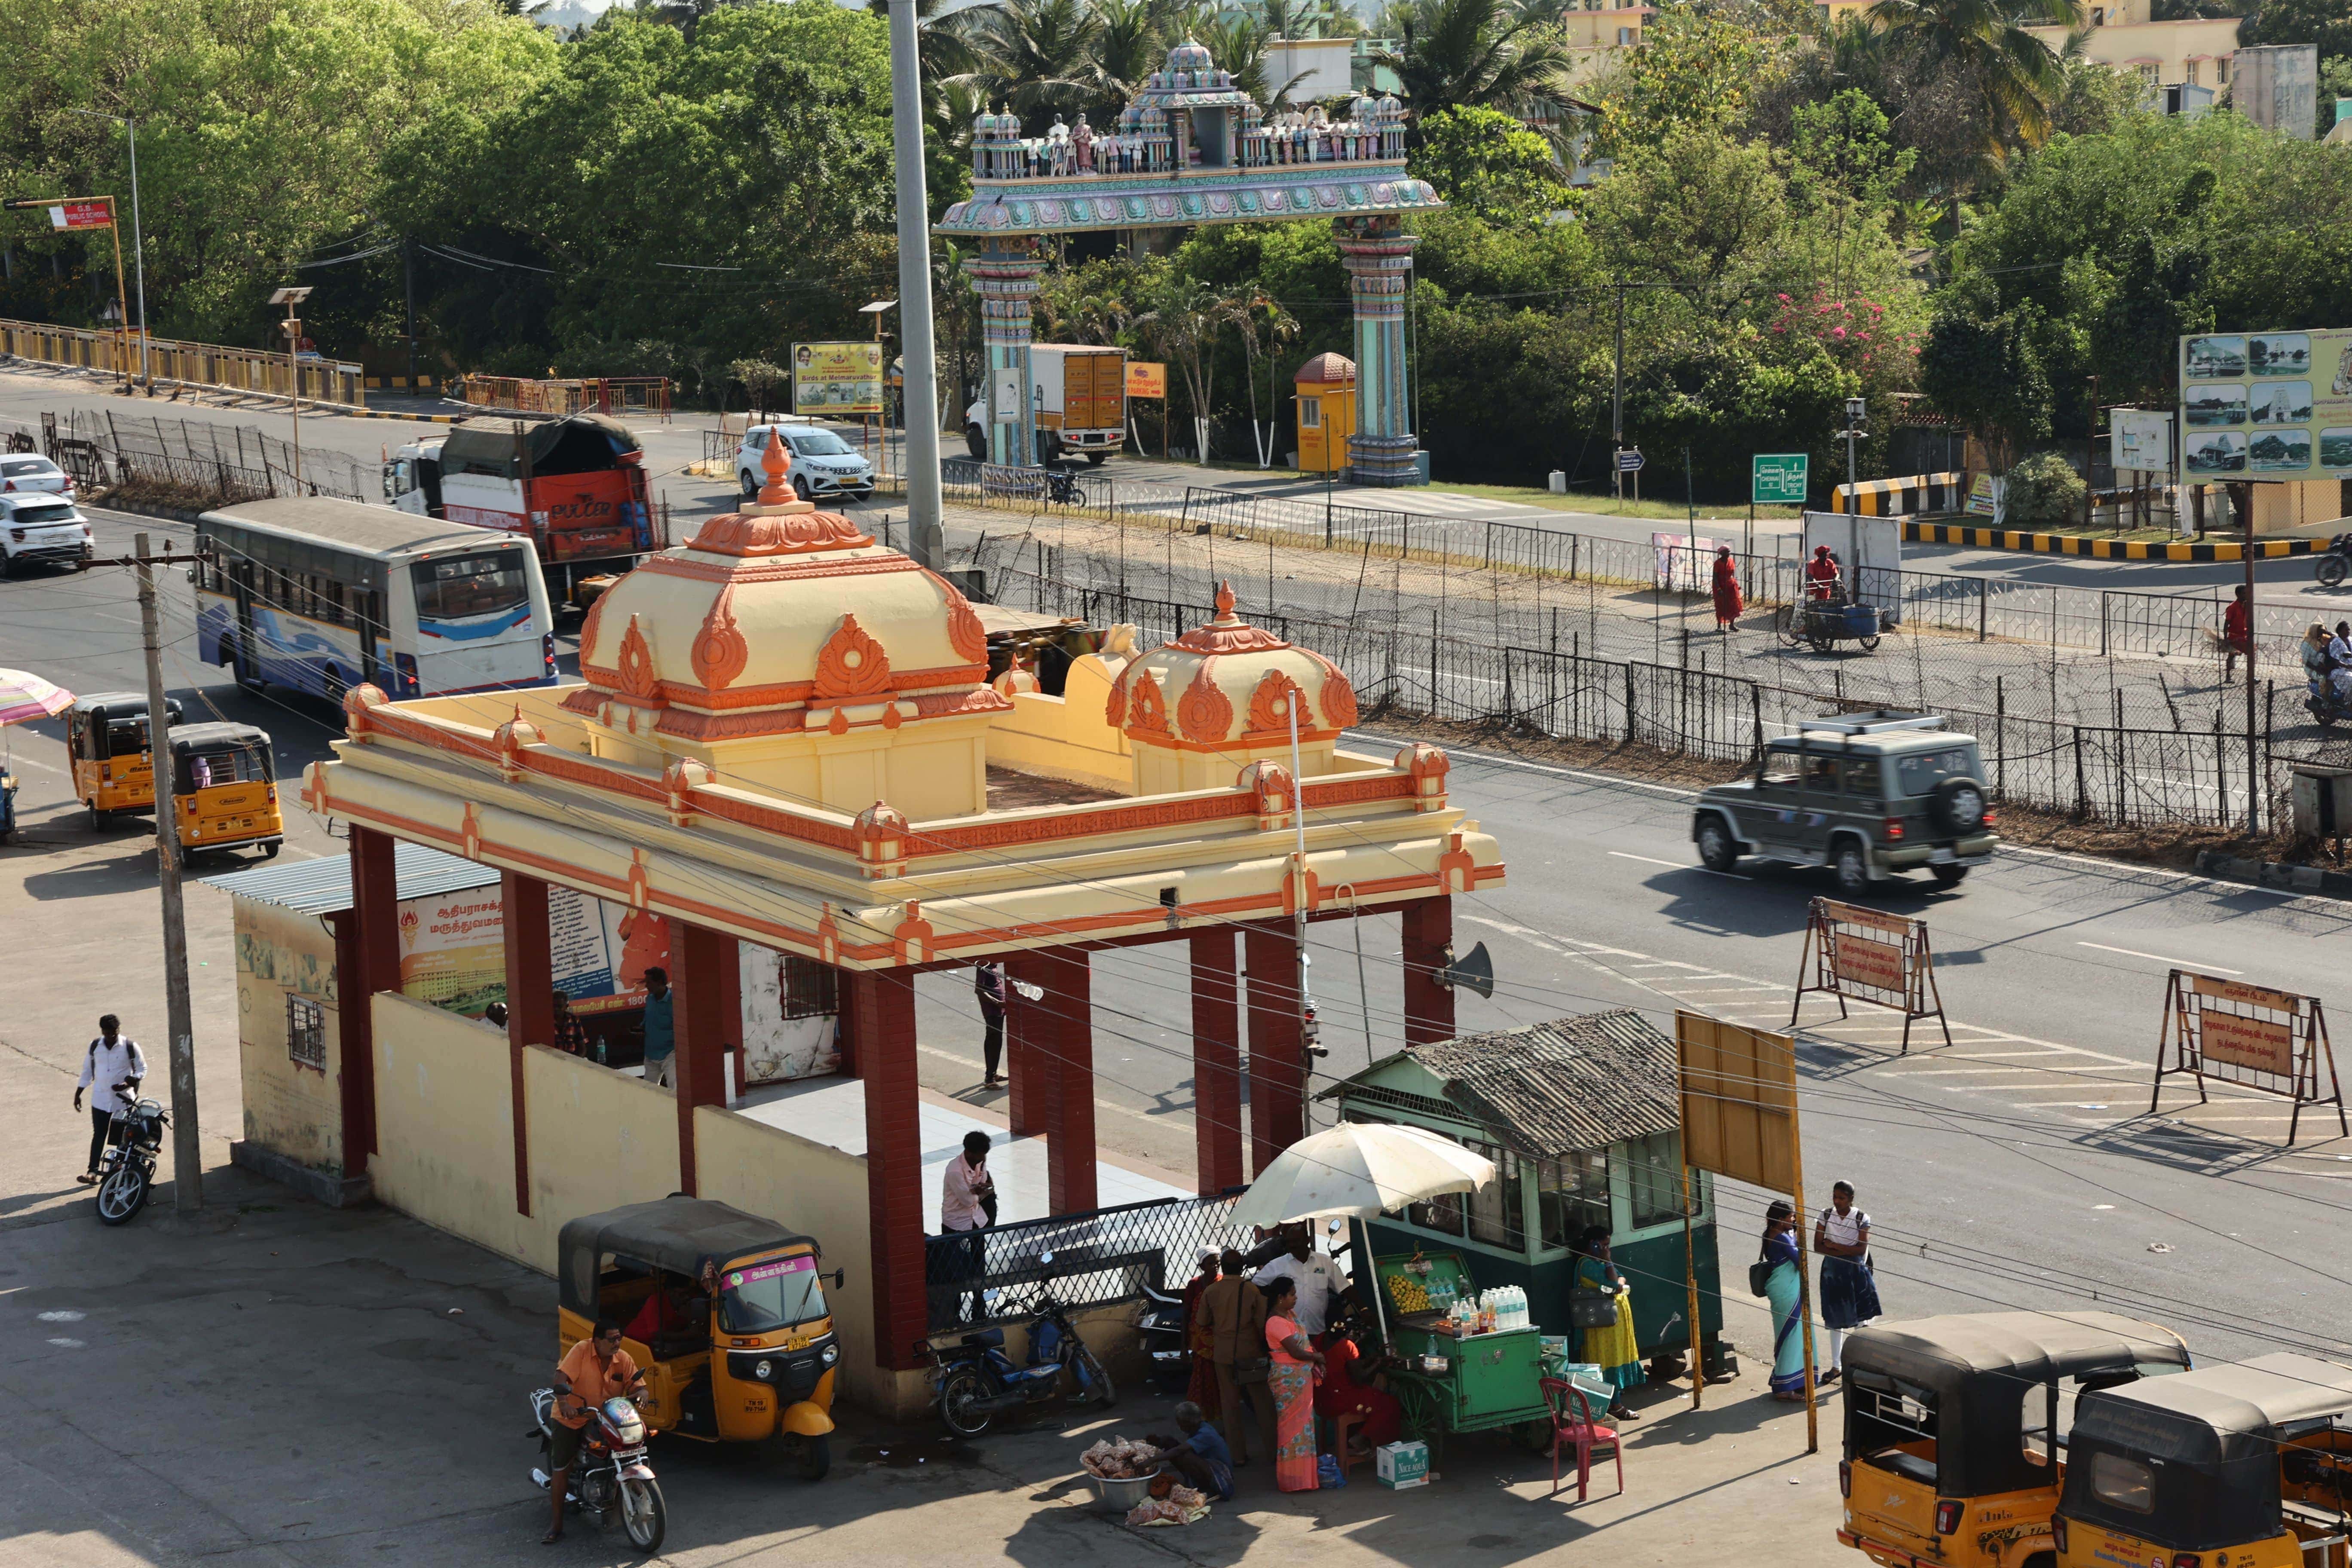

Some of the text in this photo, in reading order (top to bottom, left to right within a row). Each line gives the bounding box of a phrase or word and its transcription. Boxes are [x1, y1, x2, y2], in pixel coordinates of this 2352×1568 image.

[86, 211, 108, 219] SCHOOL
[1571, 1397, 1603, 1415] NIC QUA
[1398, 1463, 1411, 1474] NICE
[1412, 1458, 1426, 1472] AQUA
